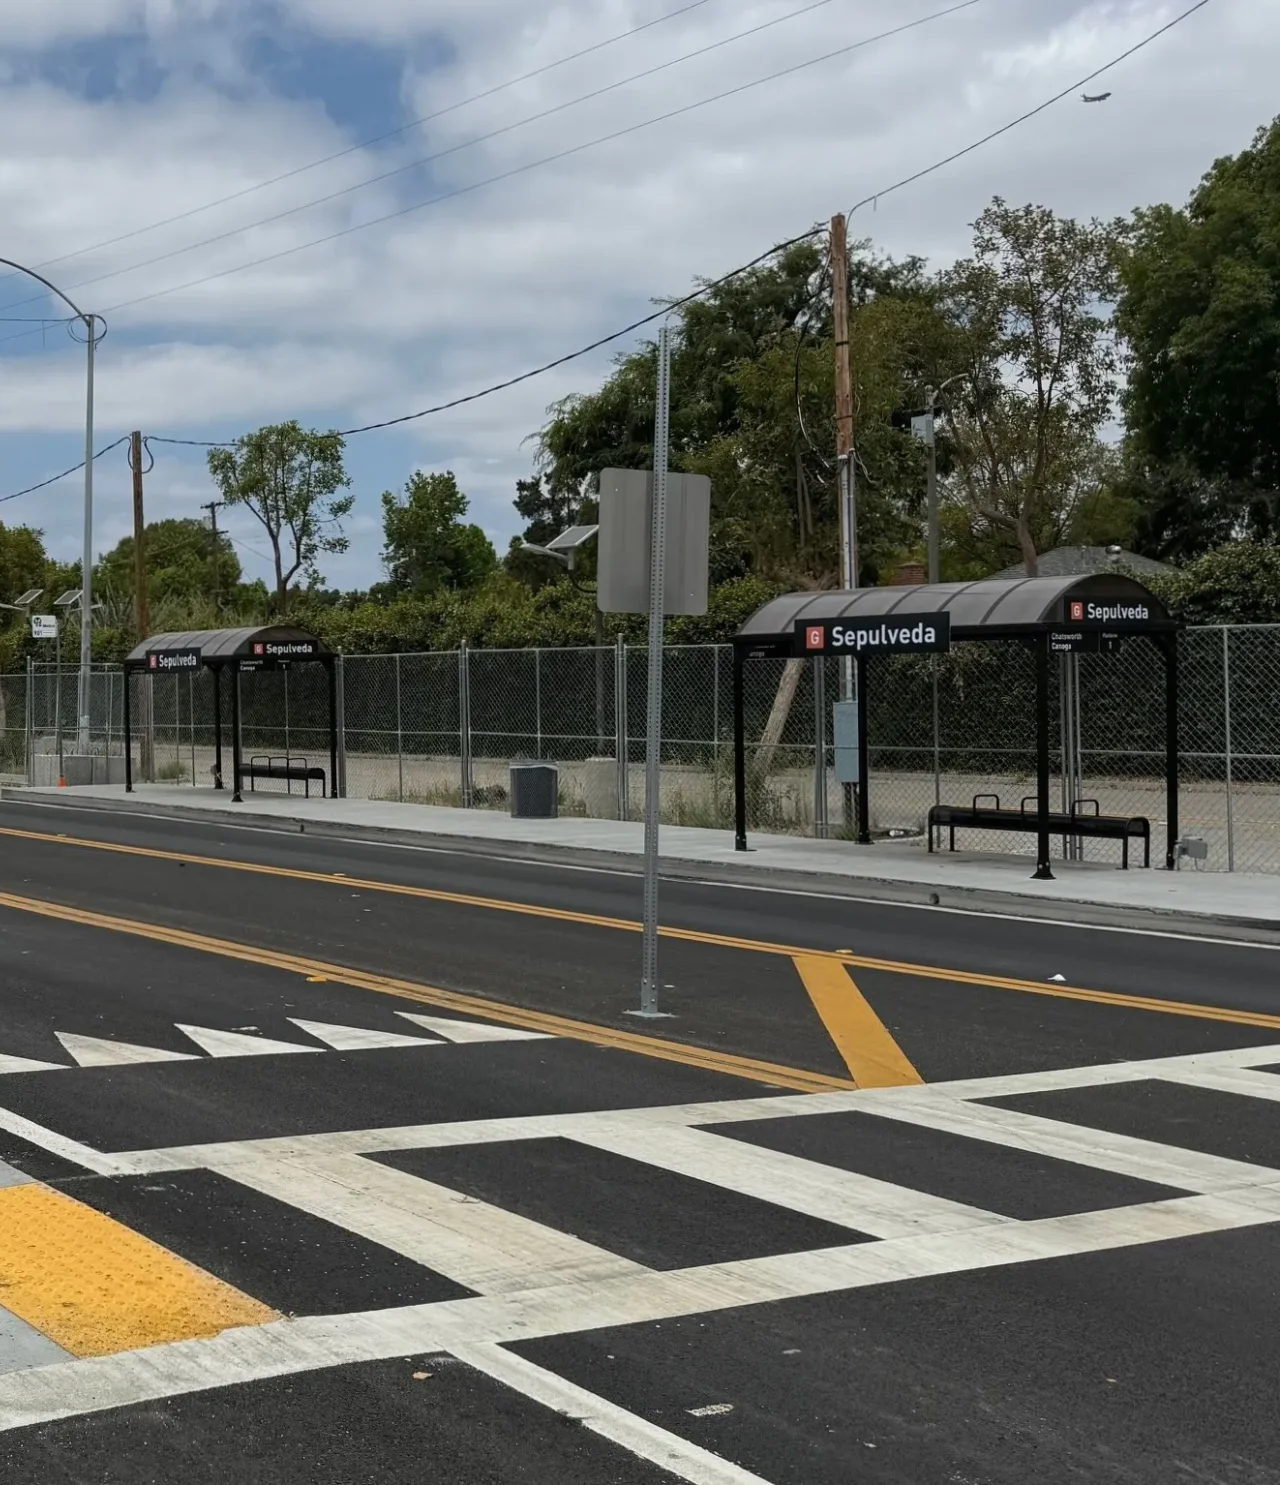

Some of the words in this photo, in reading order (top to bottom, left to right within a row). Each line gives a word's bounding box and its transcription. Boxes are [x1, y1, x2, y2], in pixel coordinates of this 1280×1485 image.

[1073, 605, 1081, 616] G
[1087, 603, 1149, 623] Sepulveda
[810, 630, 820, 645] G
[832, 622, 936, 650] Sepulveda
[266, 643, 313, 656] Sepulveda
[1051, 642, 1072, 651] Canoga
[159, 653, 197, 669] Sepulveda
